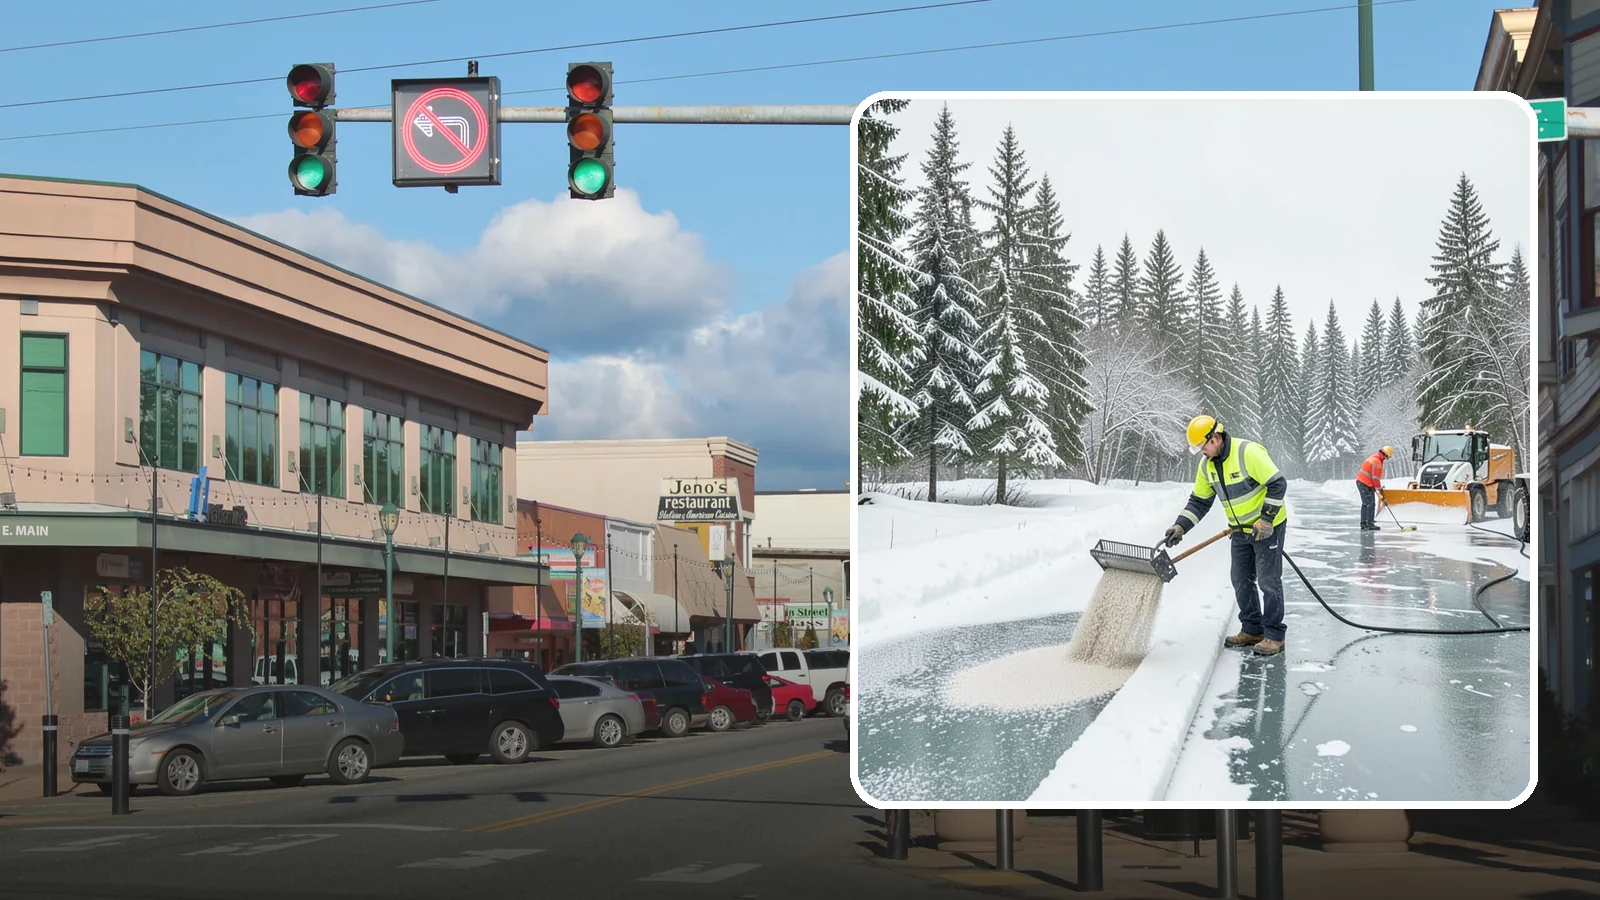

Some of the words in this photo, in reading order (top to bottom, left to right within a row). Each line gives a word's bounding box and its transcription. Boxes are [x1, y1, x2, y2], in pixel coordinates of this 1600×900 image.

[670, 480, 727, 494] Jeno's
[665, 496, 730, 508] restaurant
[658, 510, 681, 519] Italian
[686, 510, 714, 518] American
[715, 510, 738, 518] Cuisine
[2, 525, 12, 536] E.
[16, 525, 48, 536] MAIN
[798, 608, 828, 616] Street
